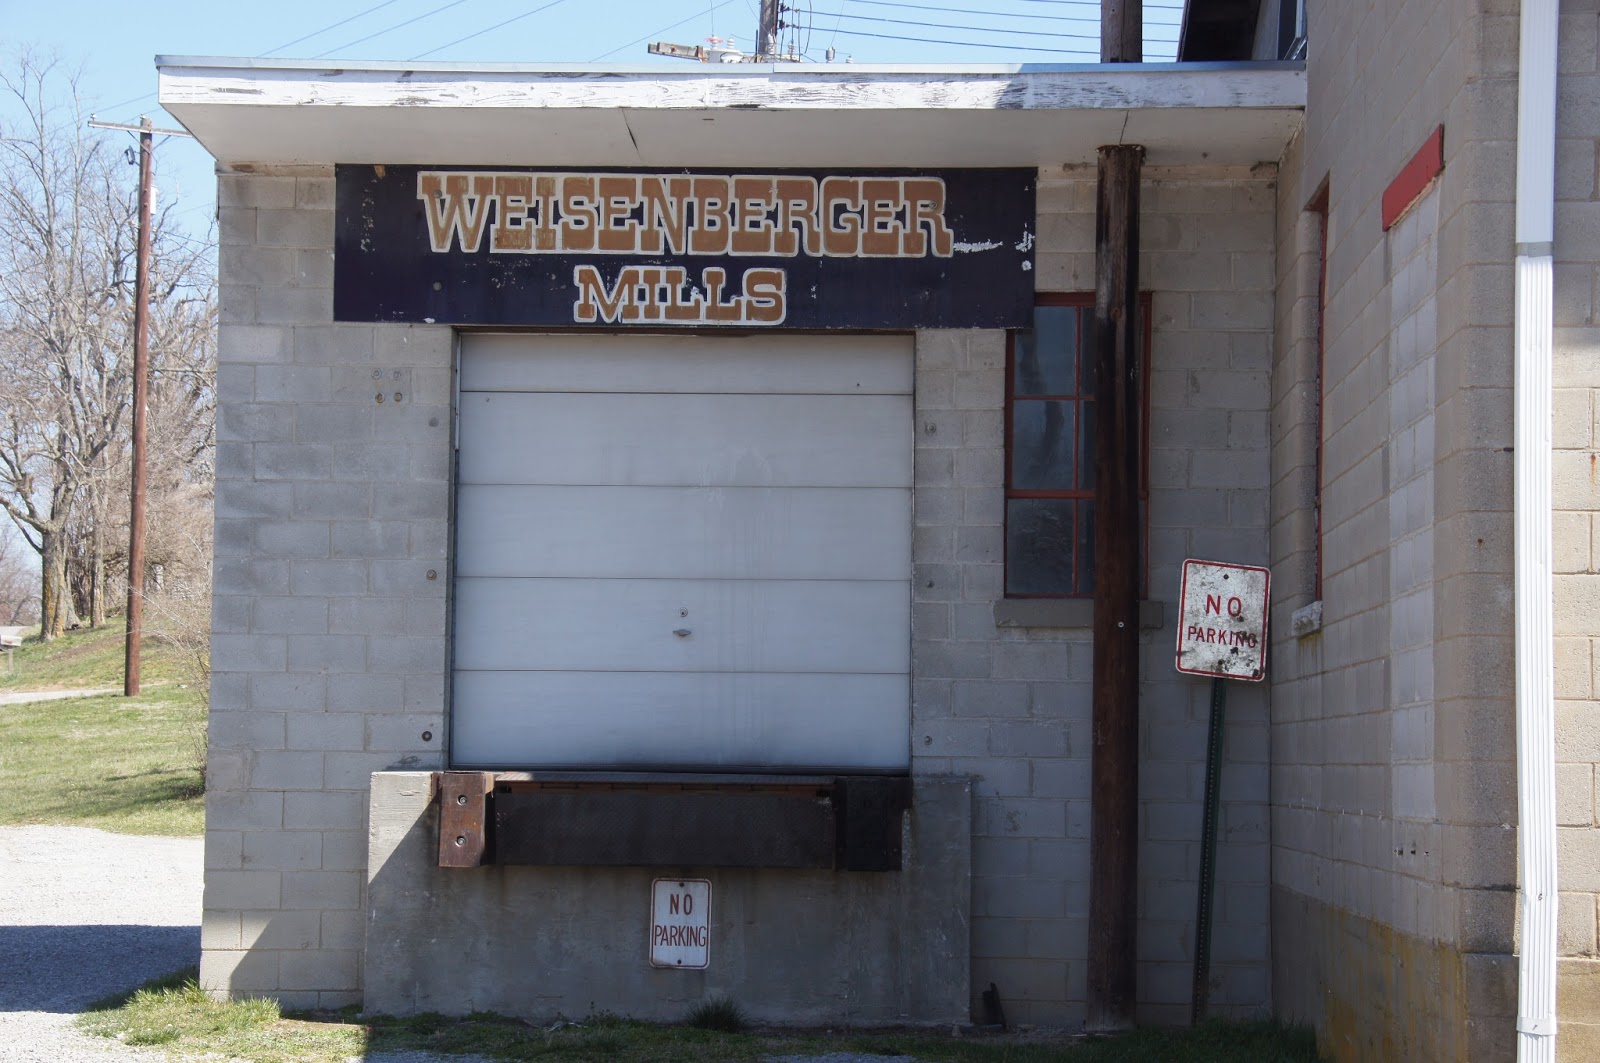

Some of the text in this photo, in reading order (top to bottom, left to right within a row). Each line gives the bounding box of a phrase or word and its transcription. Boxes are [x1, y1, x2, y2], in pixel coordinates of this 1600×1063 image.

[416, 171, 954, 259] WEISENBERGER
[572, 264, 788, 327] MILLS
[1206, 594, 1242, 617] NO
[1187, 626, 1258, 648] PARKING
[669, 894, 693, 915] NO
[654, 925, 706, 947] PARKING
